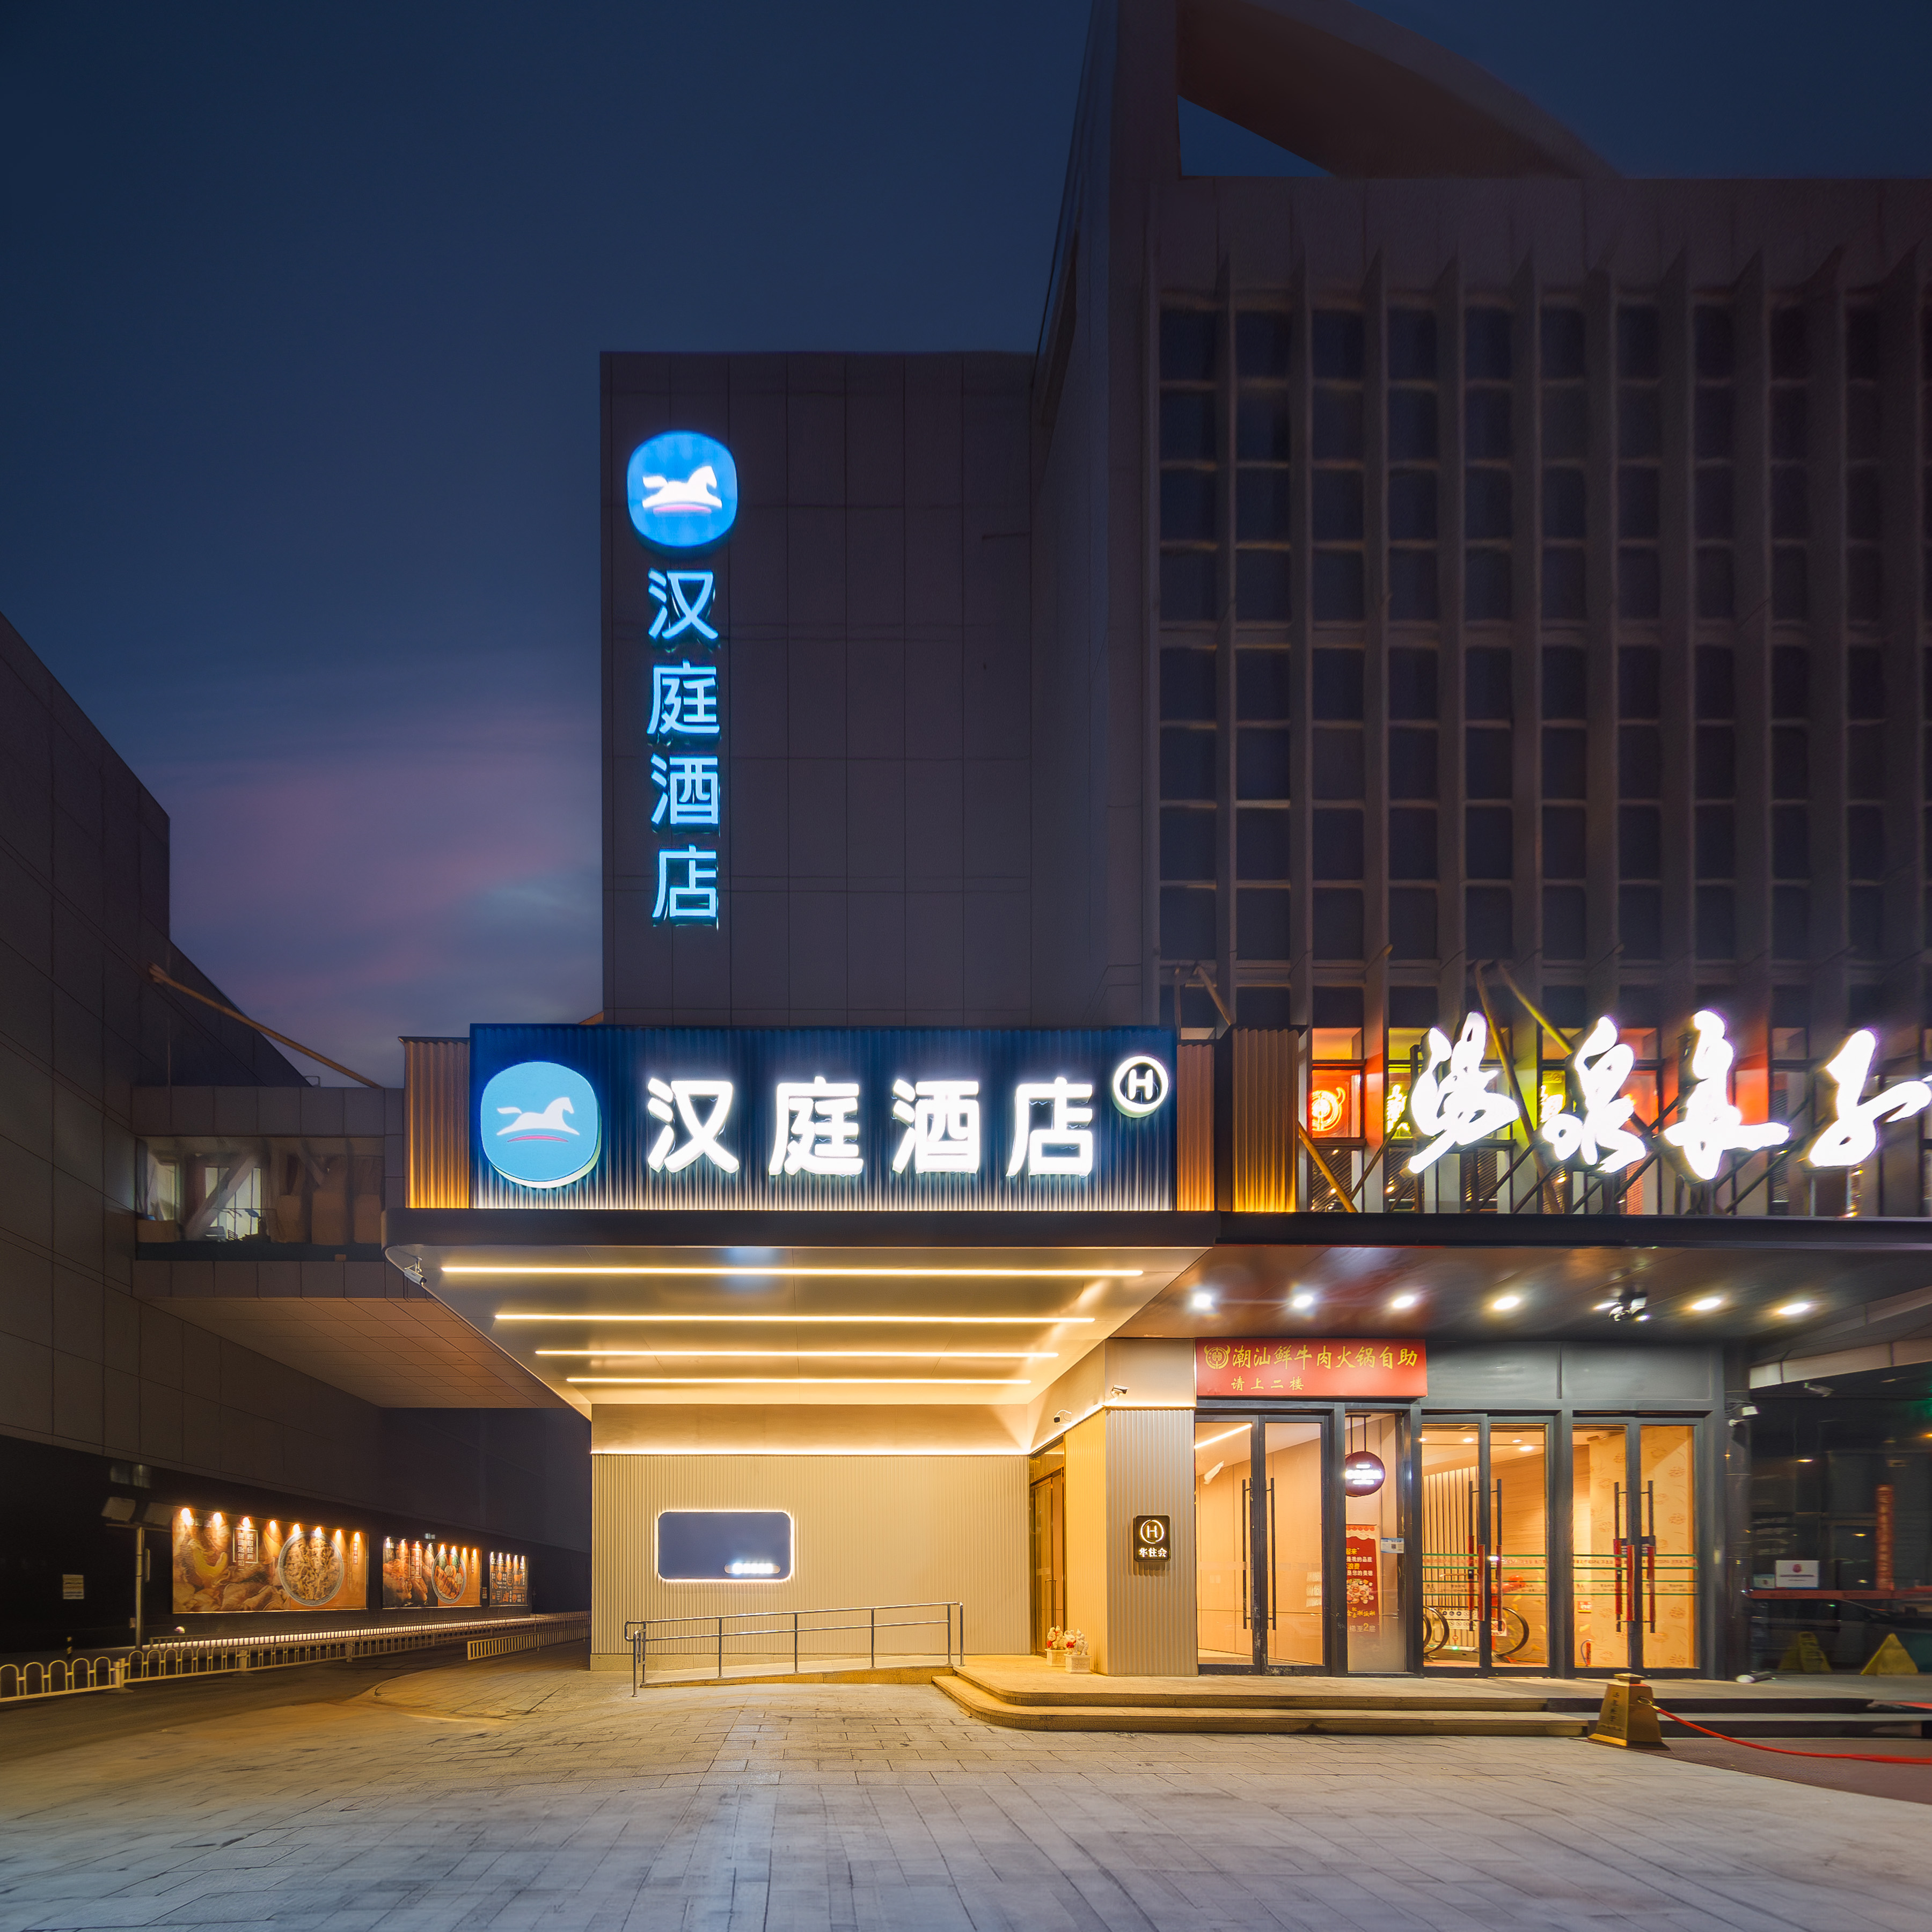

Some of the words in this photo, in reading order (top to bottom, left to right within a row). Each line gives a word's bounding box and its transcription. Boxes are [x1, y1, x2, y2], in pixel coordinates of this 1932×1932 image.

[646, 569, 720, 922] 汉庭酒店
[648, 1076, 1093, 1177] 汉庭酒店
[1232, 1344, 1418, 1370] 潮汕鲜牛肉火锅自助
[1231, 1375, 1304, 1392] 请上二楼
[1139, 1547, 1167, 1557] 华住会
